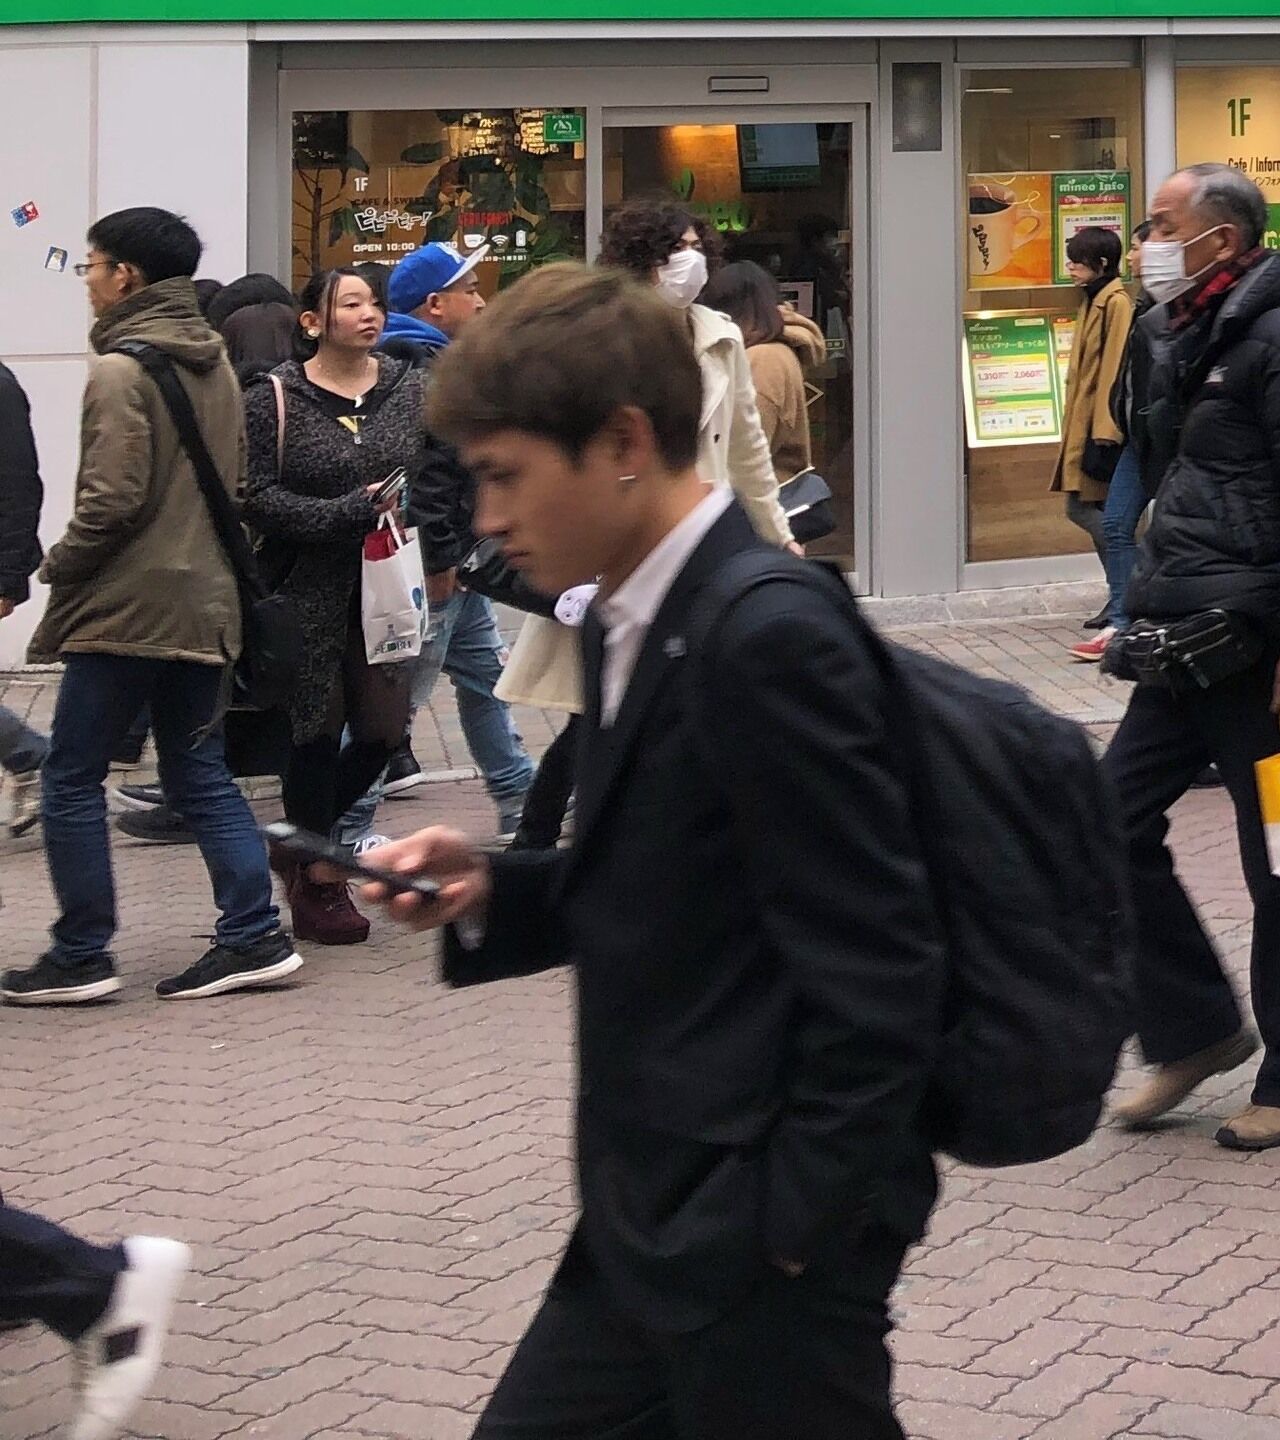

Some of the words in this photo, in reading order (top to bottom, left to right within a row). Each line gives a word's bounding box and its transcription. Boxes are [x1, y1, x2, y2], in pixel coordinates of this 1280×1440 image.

[1227, 98, 1252, 137] 1F
[354, 177, 369, 192] 1F
[1059, 178, 1096, 192] mineo
[1099, 181, 1125, 191] Info
[353, 244, 383, 253] OPEN
[386, 243, 415, 251] 10:00
